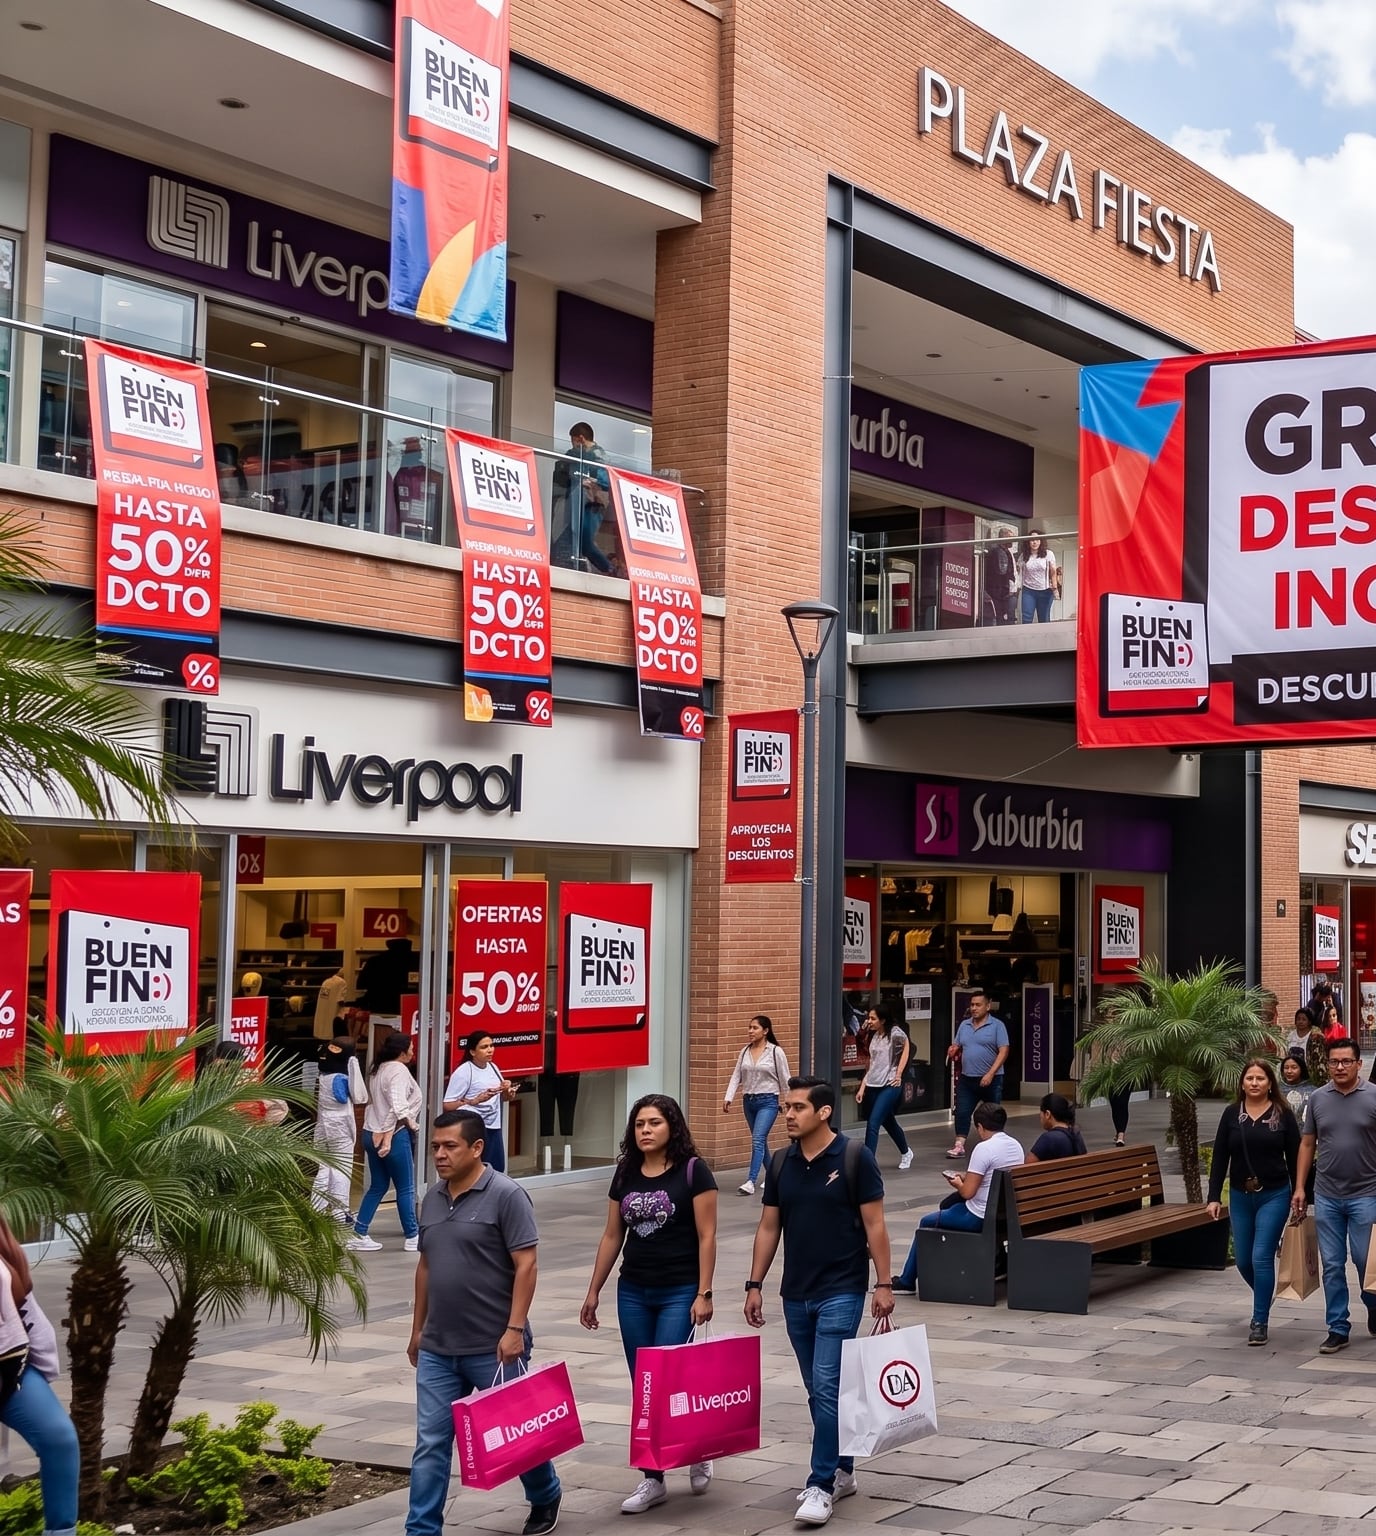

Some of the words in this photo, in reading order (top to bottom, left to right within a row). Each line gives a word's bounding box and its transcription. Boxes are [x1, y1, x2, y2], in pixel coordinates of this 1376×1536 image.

[425, 48, 489, 97] BUEN
[918, 66, 1084, 221] PLAZA
[1094, 168, 1223, 293] FIESTA
[247, 221, 390, 317] Liverp
[120, 375, 184, 409] BUEN
[851, 408, 925, 468] urbia
[471, 458, 520, 485] BUEN
[114, 493, 207, 528] HASTA
[630, 494, 672, 518] BUEN
[108, 523, 211, 577] 50%
[473, 559, 541, 588] HASTA
[106, 575, 211, 617] DCTO
[470, 585, 545, 628] 50%
[638, 583, 694, 610] HASTA
[637, 607, 696, 645] 50%
[1122, 614, 1193, 640] BUEN
[469, 629, 545, 661] DCTO
[639, 644, 697, 675] DCTO
[744, 741, 783, 756] BUEN
[270, 733, 523, 822] Liverpool
[731, 824, 792, 835] APROVECHA
[971, 793, 1083, 851] Suburbia
[728, 849, 794, 861] DESCUENTOS
[751, 837, 771, 847] LOS
[462, 905, 543, 923] OFERTAS
[843, 910, 864, 927] EN
[1106, 911, 1135, 928] BUEN
[85, 938, 172, 968] BUEN
[475, 938, 528, 953] HASTA
[581, 935, 635, 960] BUEN
[459, 970, 540, 1016] 50%
[691, 1384, 751, 1413] Liverpool
[505, 1401, 569, 1443] Liverpool
